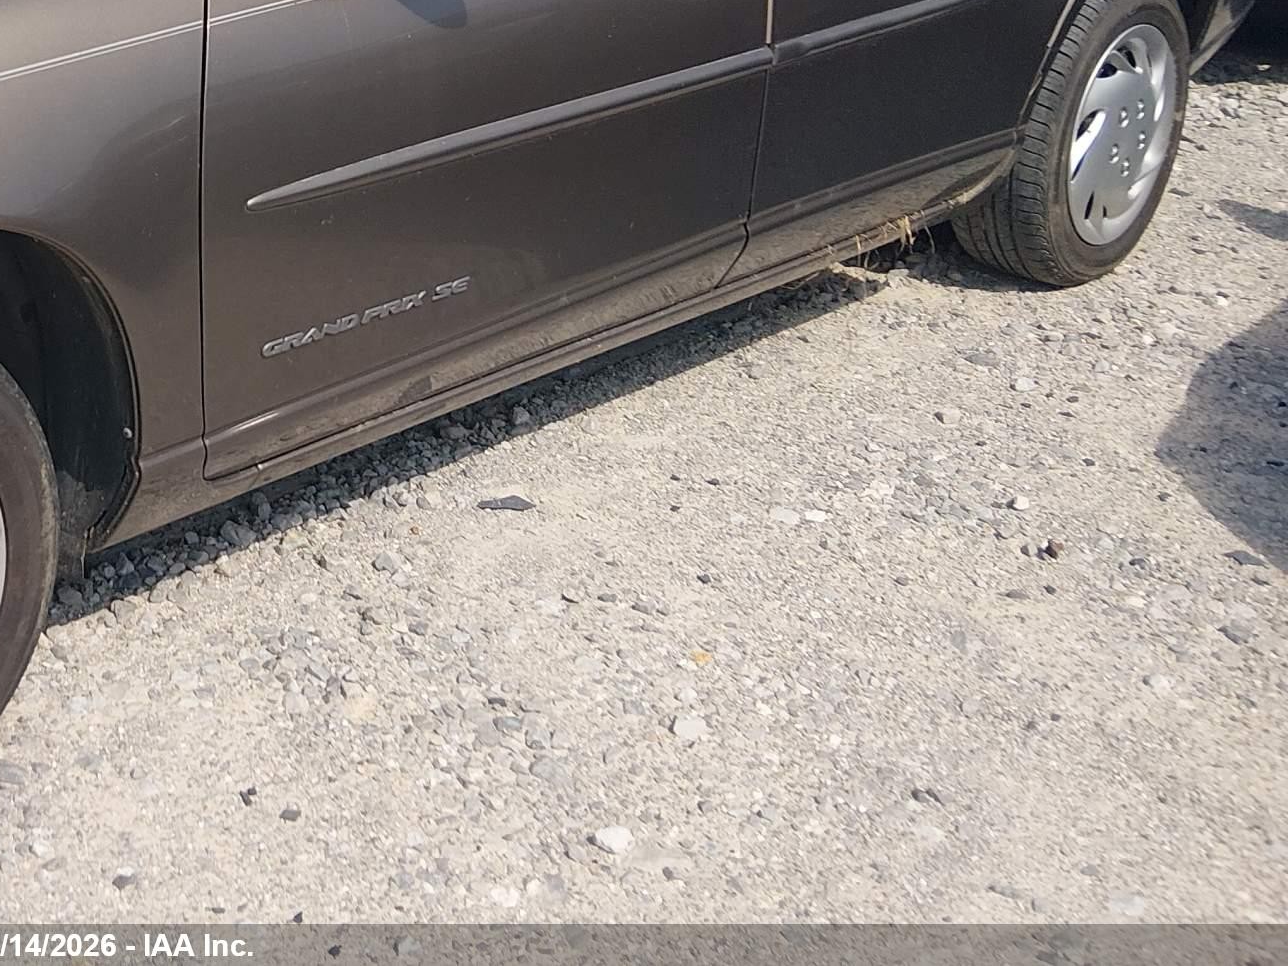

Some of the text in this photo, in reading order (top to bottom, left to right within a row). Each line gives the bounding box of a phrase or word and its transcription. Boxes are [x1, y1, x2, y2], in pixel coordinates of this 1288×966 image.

[262, 276, 471, 357] GRAND PRIX SE
